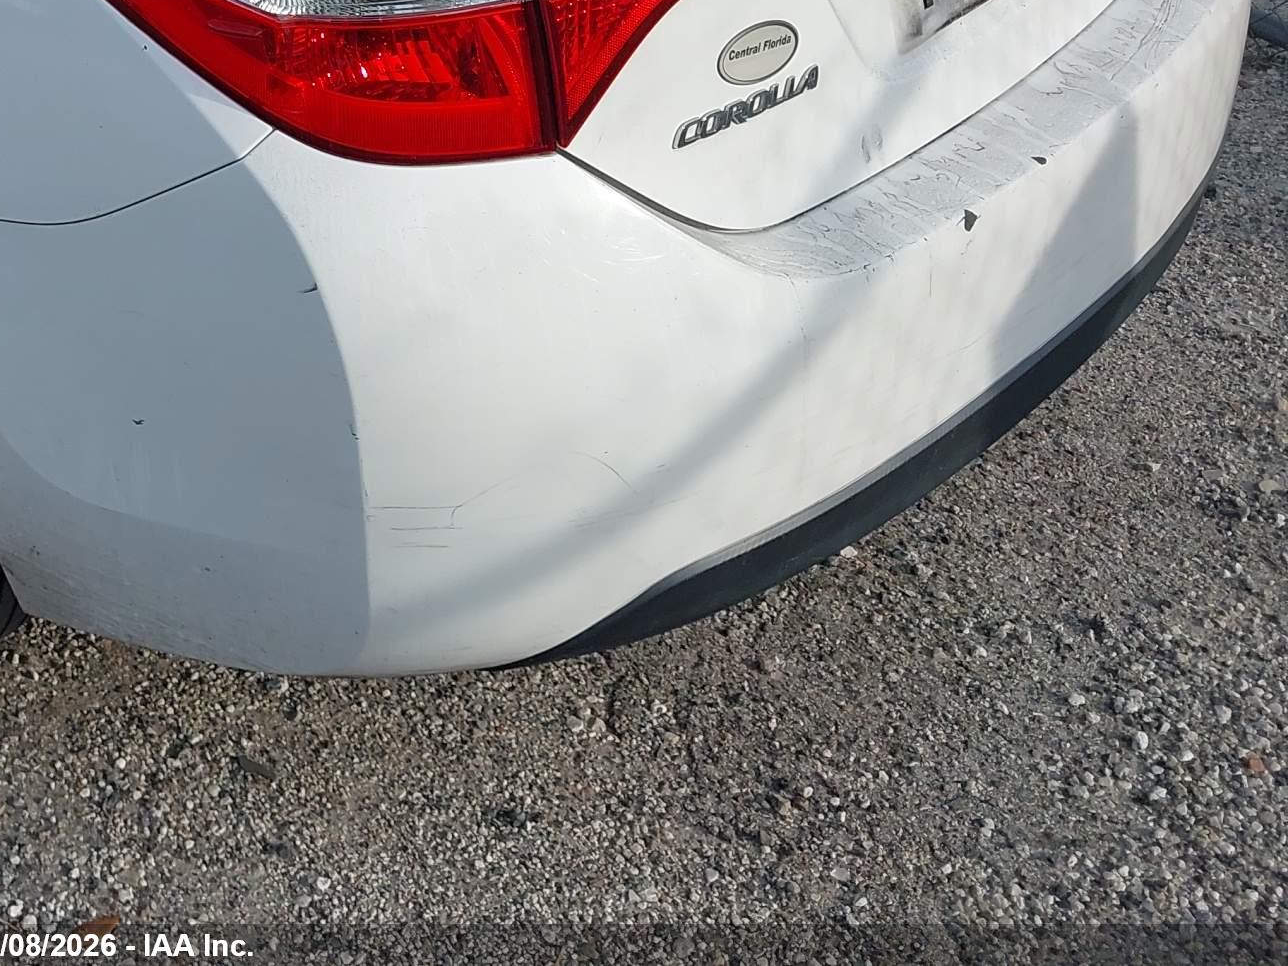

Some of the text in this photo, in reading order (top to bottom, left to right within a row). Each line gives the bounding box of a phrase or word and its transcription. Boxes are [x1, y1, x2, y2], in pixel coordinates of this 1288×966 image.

[728, 34, 792, 61] Central Florida
[672, 64, 819, 149] COROLLA
